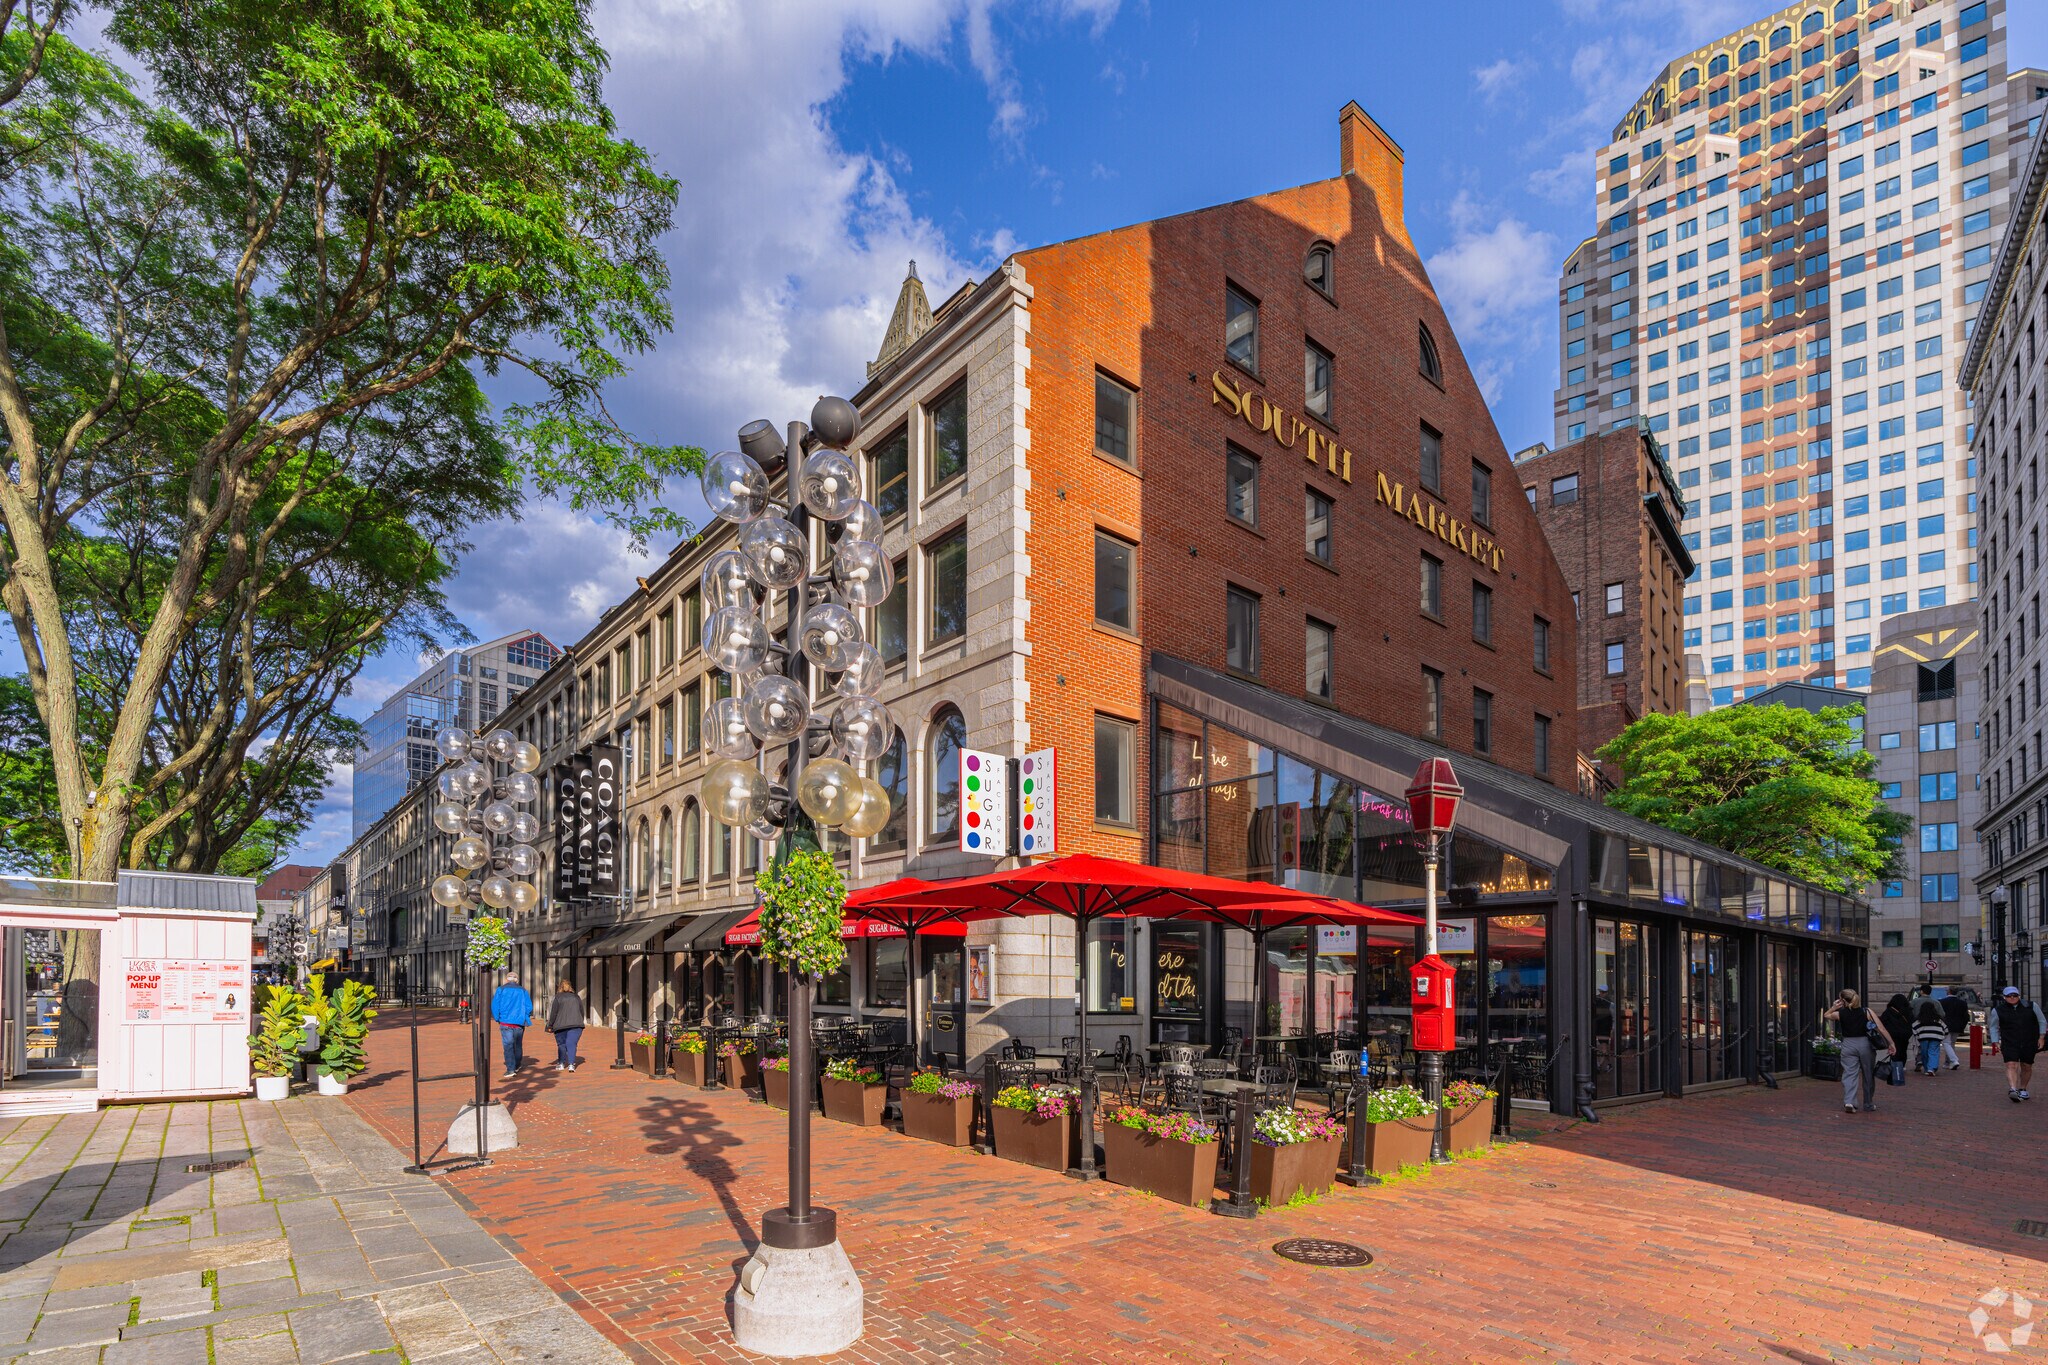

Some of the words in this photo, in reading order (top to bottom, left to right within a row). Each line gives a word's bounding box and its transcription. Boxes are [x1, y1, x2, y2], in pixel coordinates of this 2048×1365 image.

[1212, 370, 1352, 485] SOUTH
[1376, 470, 1505, 574] MARKET
[1192, 740, 1229, 767] Lve
[561, 778, 575, 890] COACH
[578, 768, 593, 886] COACH
[597, 757, 614, 882] COACH
[983, 759, 993, 850] SUGAR
[1035, 757, 1044, 848] SUGAR
[623, 943, 641, 951] COACH
[728, 934, 740, 942] SUGAR
[869, 924, 888, 933] SUGAR
